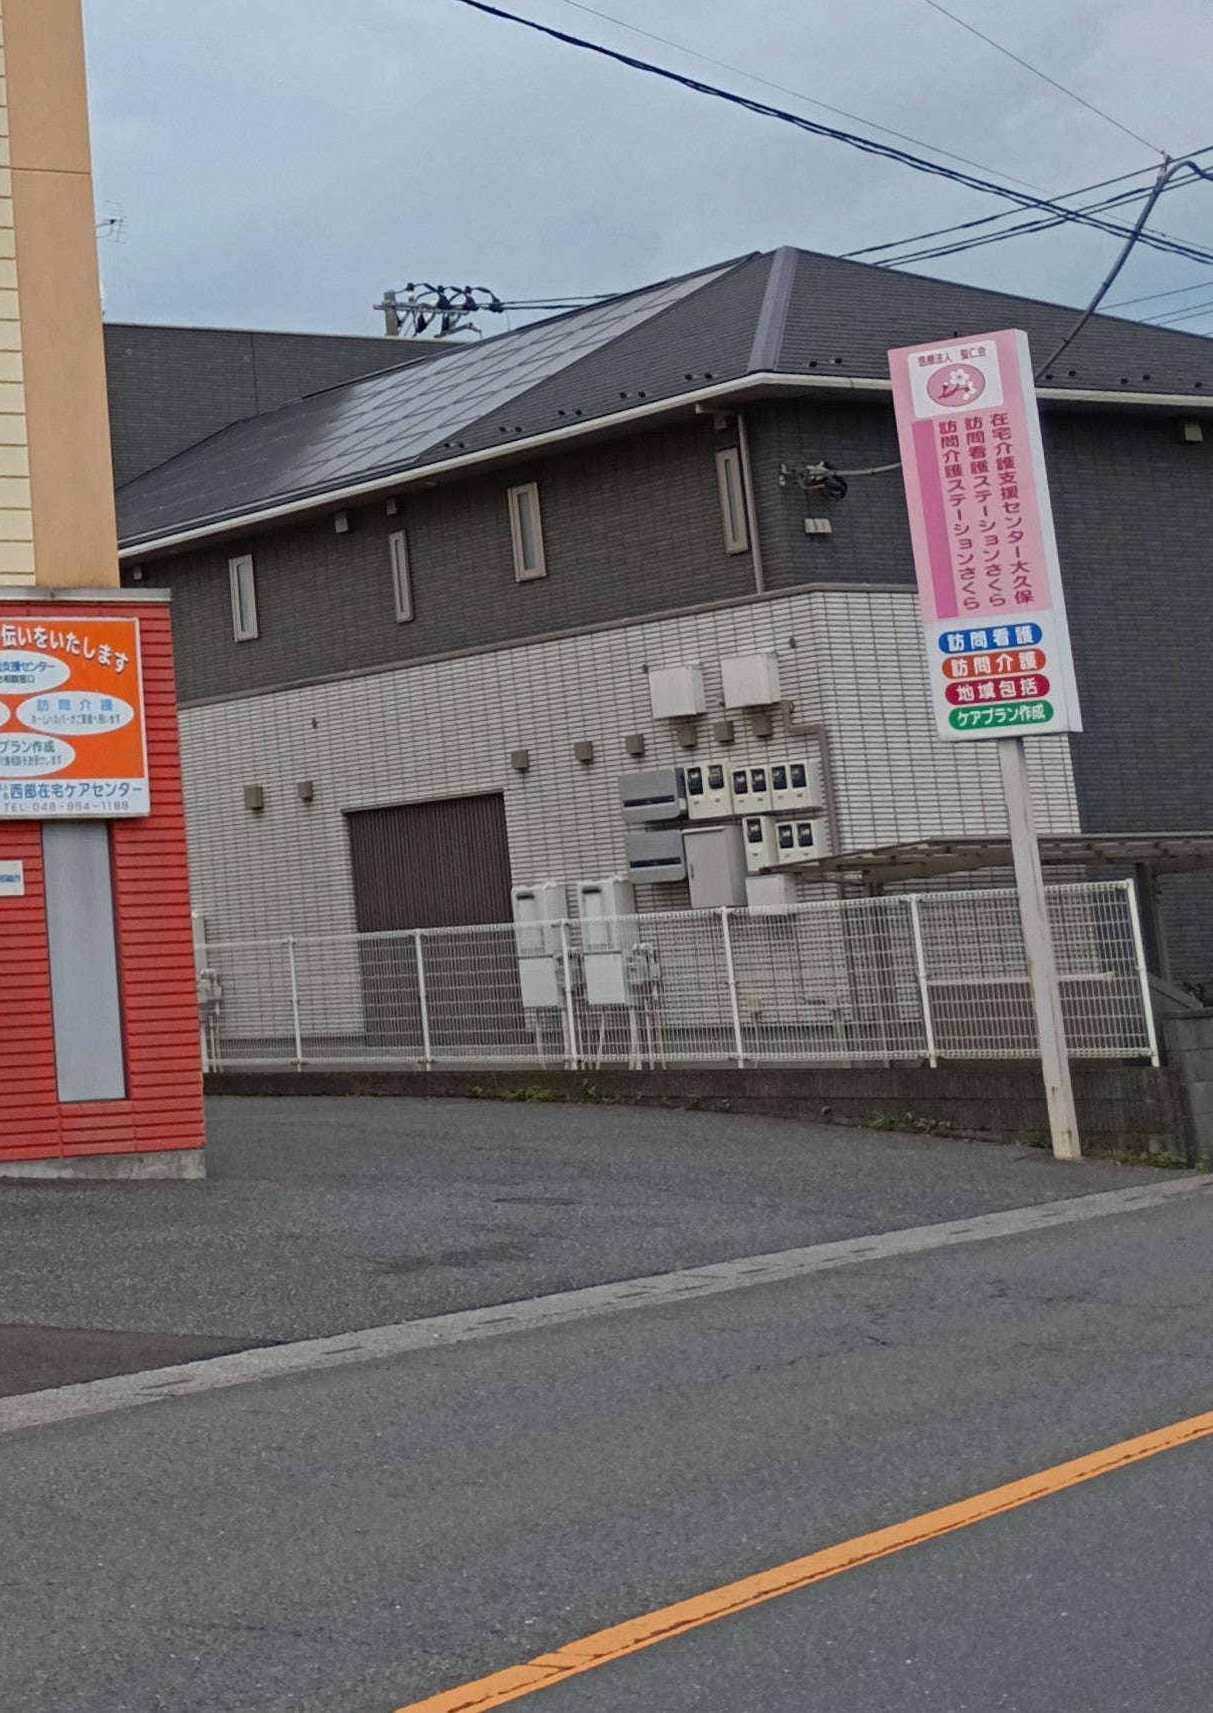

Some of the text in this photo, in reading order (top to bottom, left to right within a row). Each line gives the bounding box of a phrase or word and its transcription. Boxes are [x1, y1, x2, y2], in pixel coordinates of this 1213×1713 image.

[938, 420, 980, 610] 訪問介護ステーションさくら
[965, 416, 1007, 607] 訪問看護ステーションさくら
[990, 412, 1034, 604] 在宅介護支援センター大久保
[947, 626, 1034, 652] 訪問看護
[951, 651, 1038, 677] 訪問介護
[957, 677, 1038, 701] 地域包括
[36, 699, 113, 712] 訪問介護
[957, 703, 1045, 727] ケアプラン作成
[10, 782, 142, 799] 西部在宅ケアセンター
